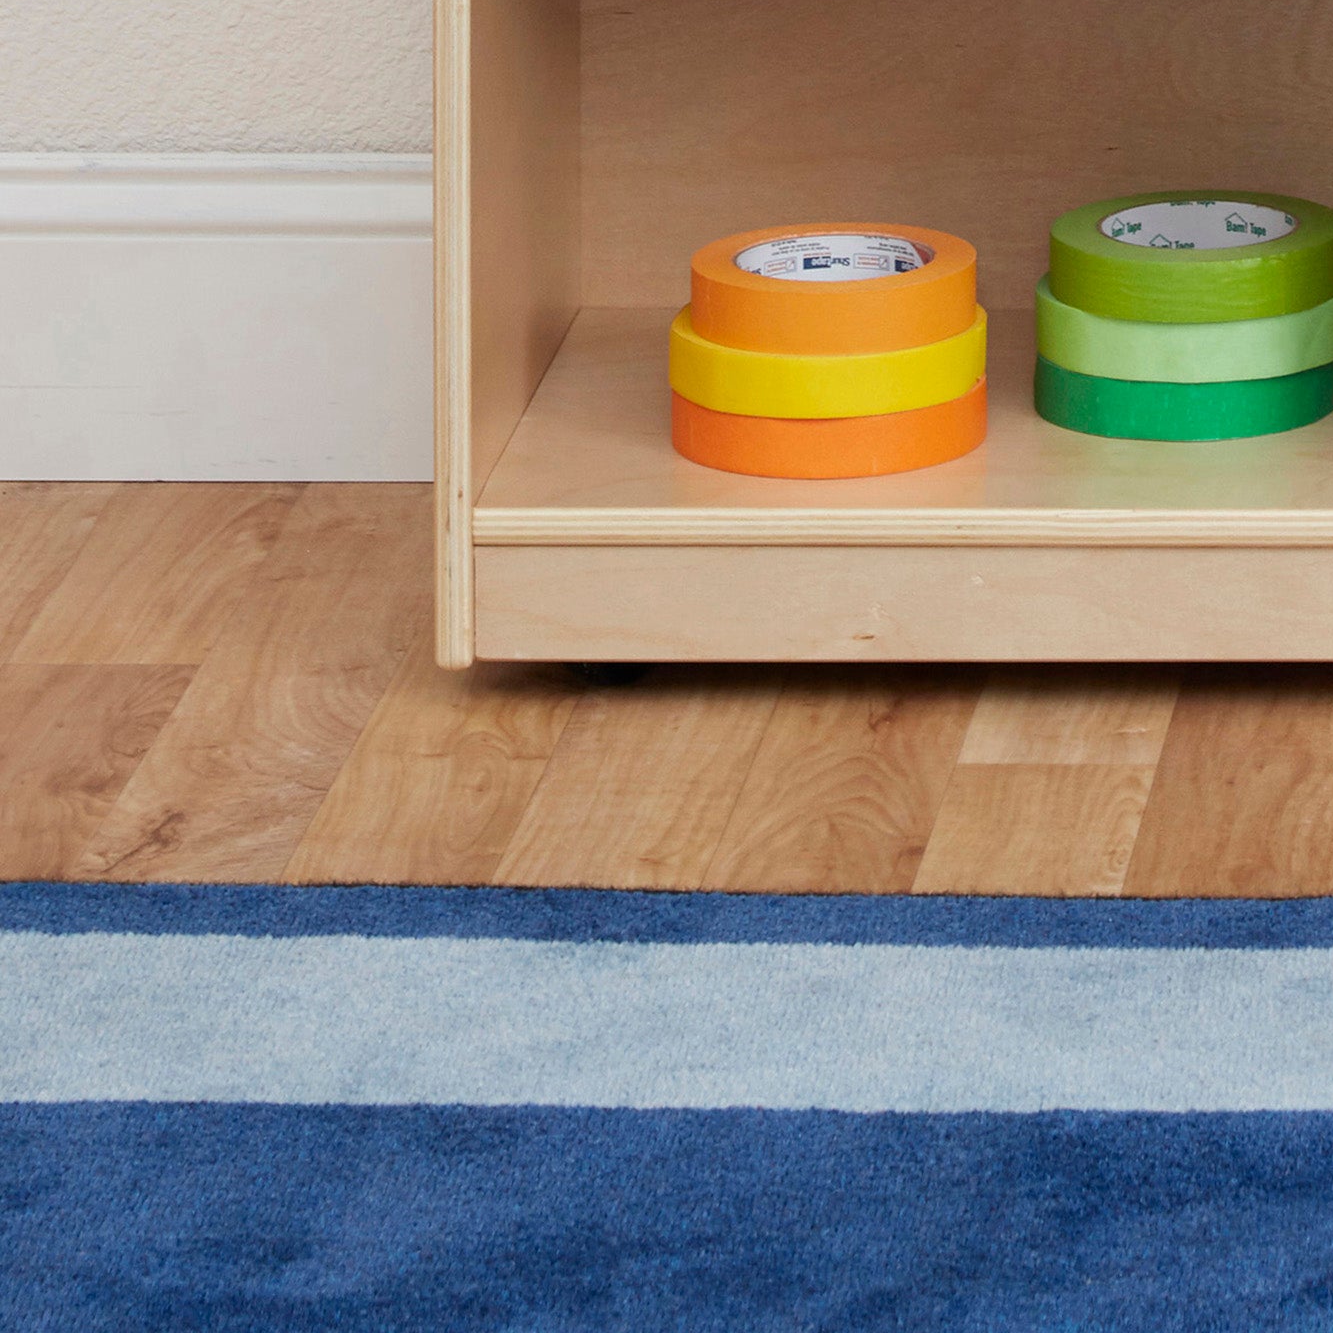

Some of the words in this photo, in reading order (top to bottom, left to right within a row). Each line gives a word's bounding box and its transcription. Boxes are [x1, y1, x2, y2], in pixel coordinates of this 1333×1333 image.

[1126, 221, 1142, 235] Tape
[1225, 220, 1248, 233] Bam!
[1249, 223, 1267, 238] Tape
